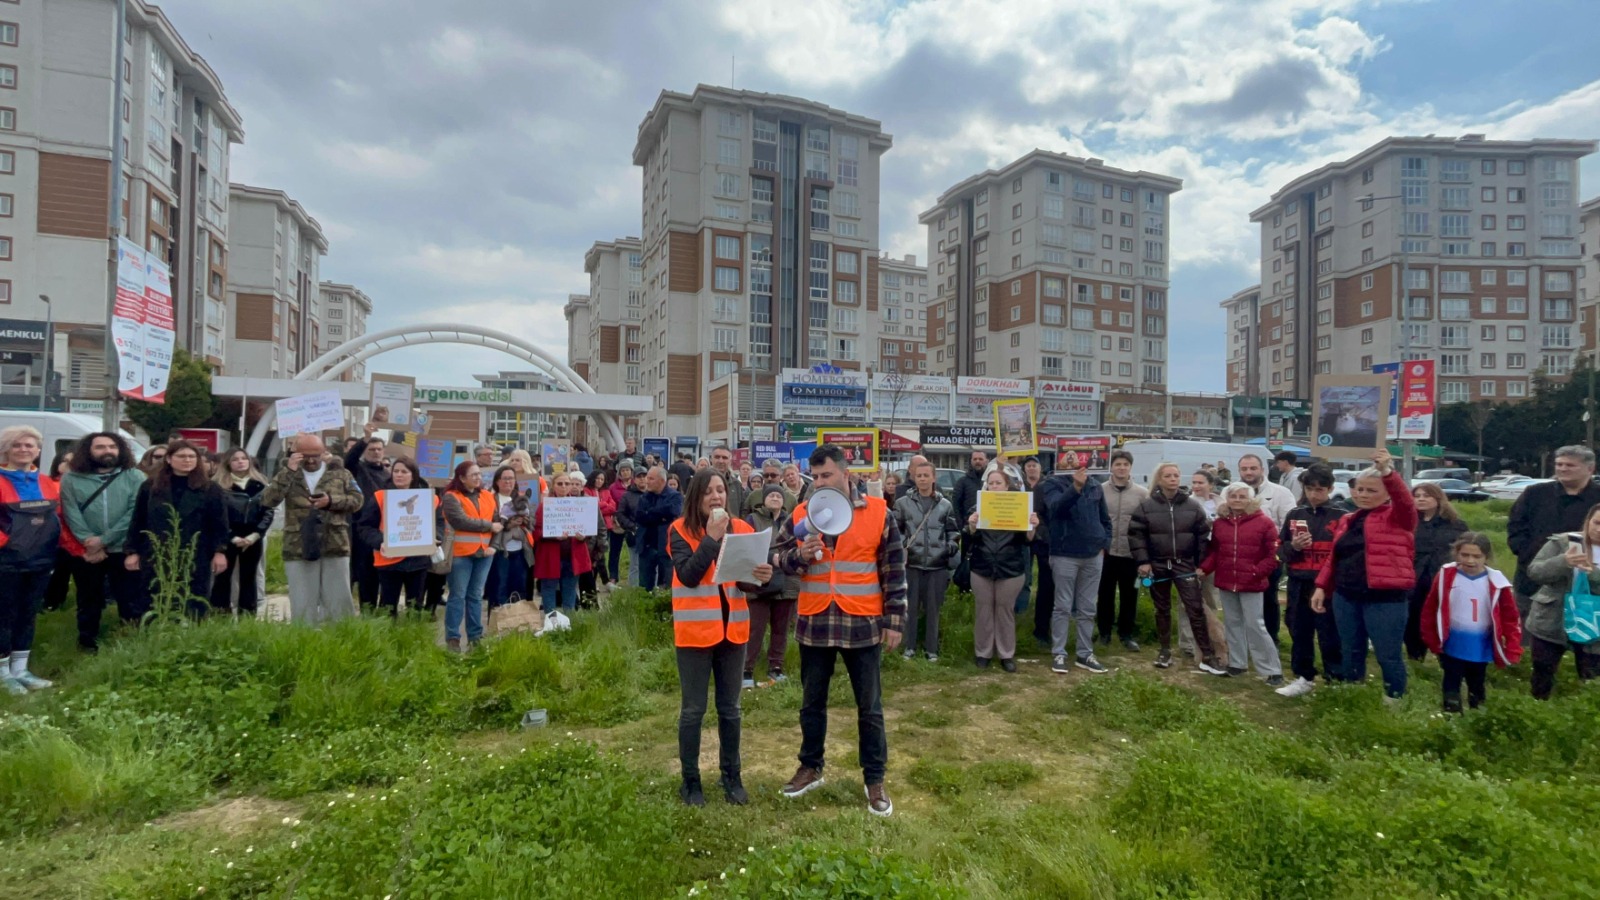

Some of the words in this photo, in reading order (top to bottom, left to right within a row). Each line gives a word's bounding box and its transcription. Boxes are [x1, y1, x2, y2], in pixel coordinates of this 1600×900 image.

[967, 379, 1021, 389] DORUKHAN
[1055, 382, 1094, 393] YAĞMUR
[1051, 401, 1093, 412] YAĞMUR
[950, 426, 962, 435] ÖZ
[964, 428, 993, 436] BAFRA
[927, 435, 977, 445] KARADENİZ
[1470, 598, 1478, 622] 1
